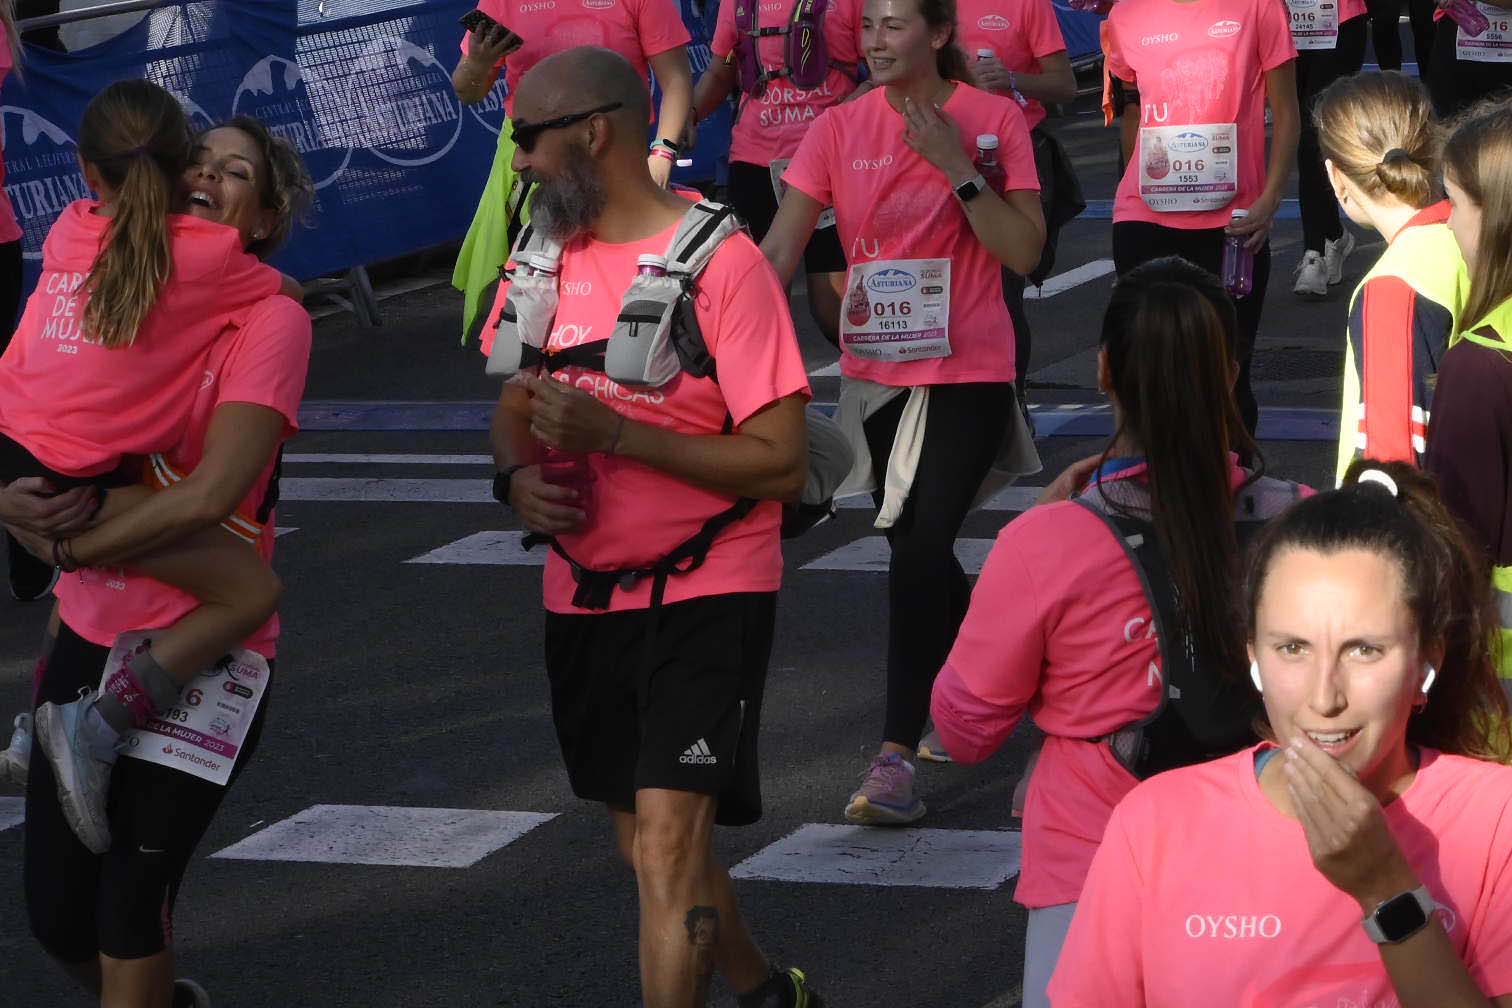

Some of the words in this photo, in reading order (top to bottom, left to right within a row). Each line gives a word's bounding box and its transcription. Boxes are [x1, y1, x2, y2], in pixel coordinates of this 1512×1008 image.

[520, 0, 557, 14] OYSHO
[1293, 12, 1316, 22] 016
[1141, 32, 1179, 46] OYSHO
[1172, 159, 1206, 171] 016
[1179, 175, 1199, 183] 1553
[53, 297, 75, 317] DE
[873, 301, 912, 316] 016
[879, 320, 908, 330] 16113
[173, 746, 222, 772] Santander
[679, 753, 718, 765] adidas
[1185, 913, 1282, 939] OYSHO
